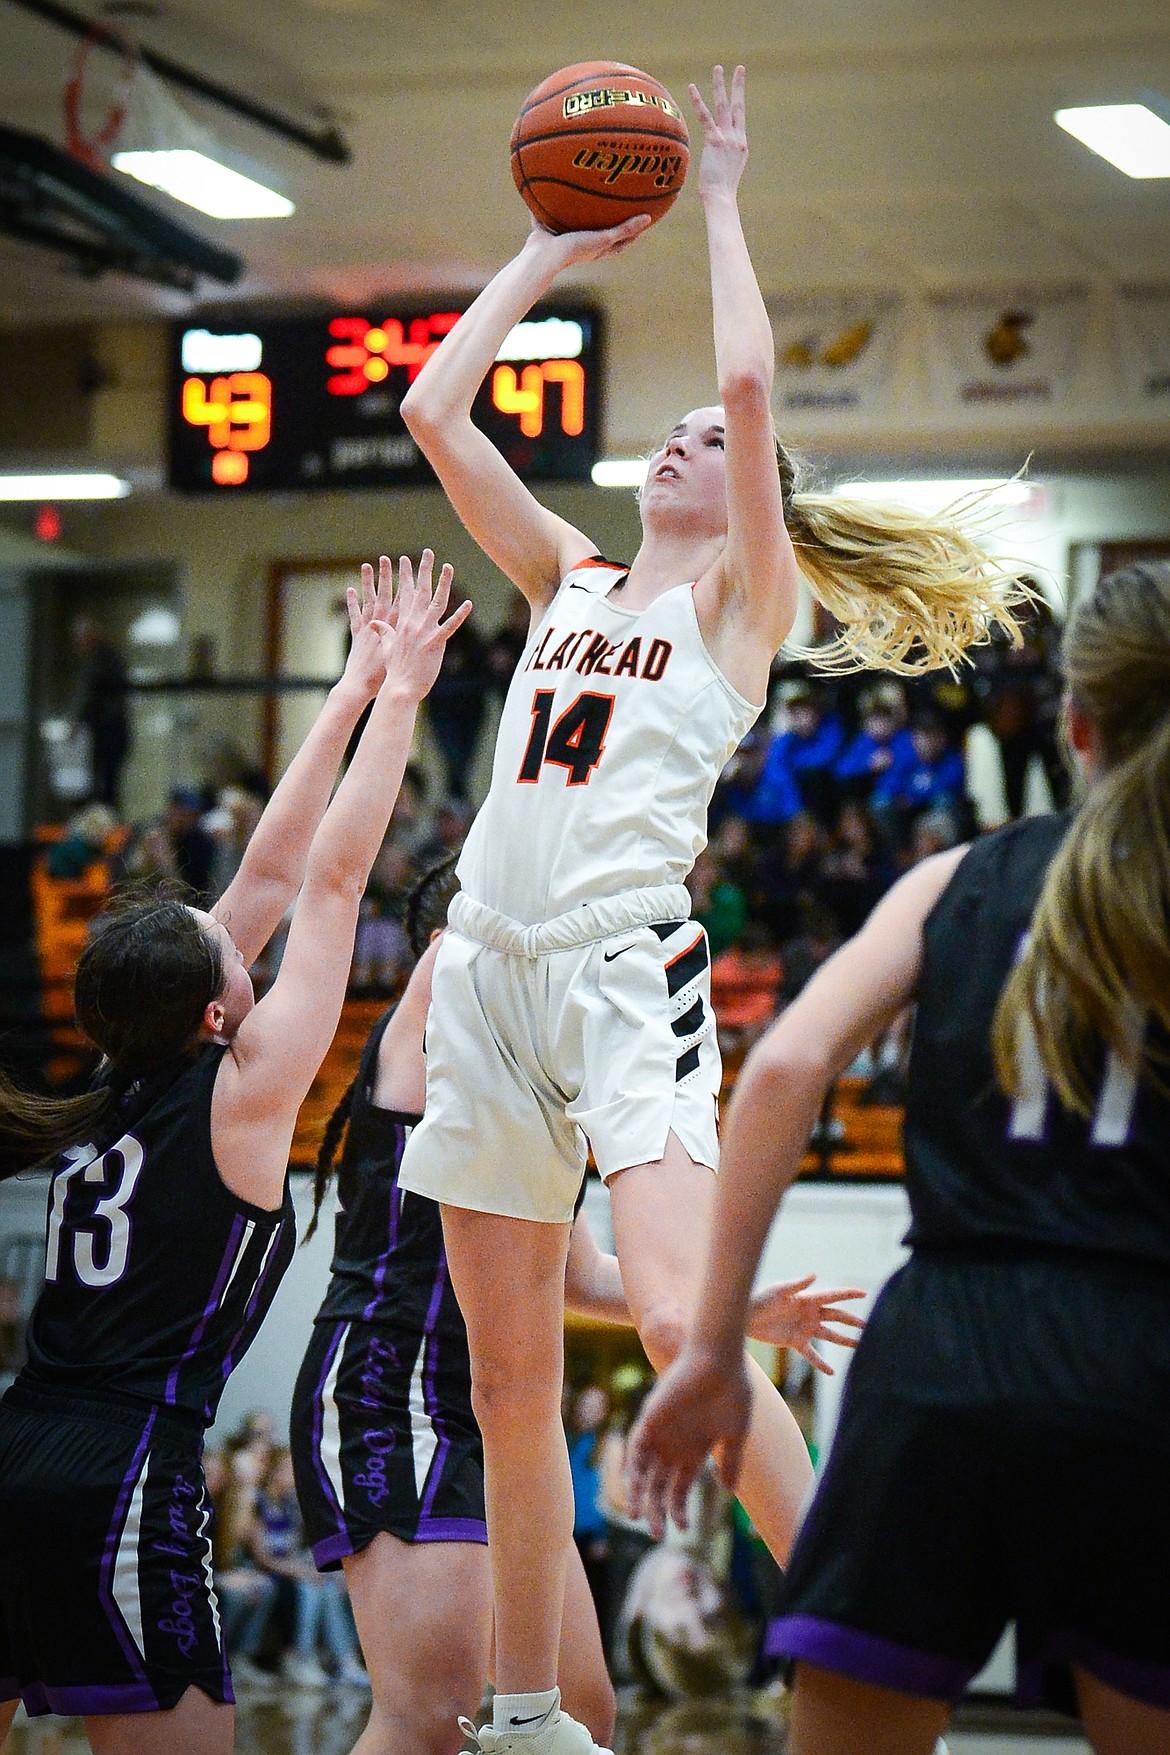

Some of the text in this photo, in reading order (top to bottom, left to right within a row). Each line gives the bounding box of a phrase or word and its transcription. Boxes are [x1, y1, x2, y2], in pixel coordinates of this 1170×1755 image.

[572, 148, 682, 188] Baden
[183, 373, 272, 451] 43
[493, 359, 584, 438] 47
[524, 627, 673, 682] LATHEAD
[516, 688, 616, 787] 14
[45, 1133, 145, 1288] 13
[353, 1428, 396, 1508] Dogs
[157, 1569, 200, 1659] Dogs
